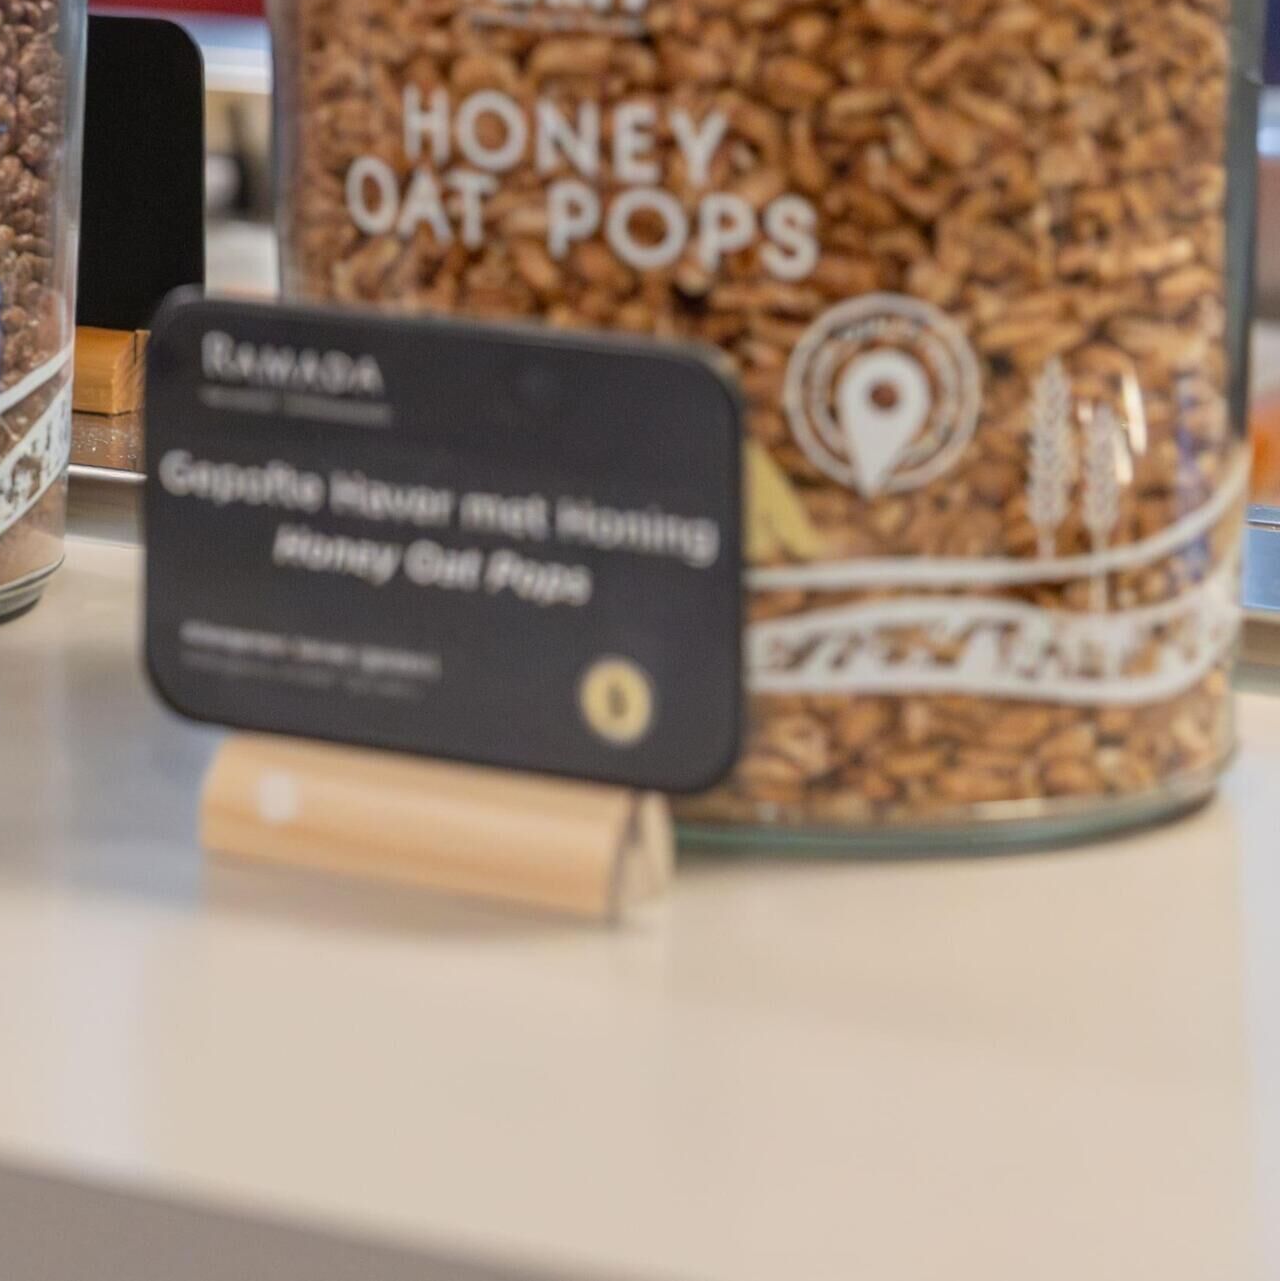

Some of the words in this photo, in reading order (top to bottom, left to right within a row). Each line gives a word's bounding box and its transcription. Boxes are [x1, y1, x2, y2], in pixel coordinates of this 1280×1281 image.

[402, 83, 728, 186] HONEY
[345, 156, 498, 248] OAT
[547, 180, 819, 281] POPS
[272, 522, 401, 586] Honey
